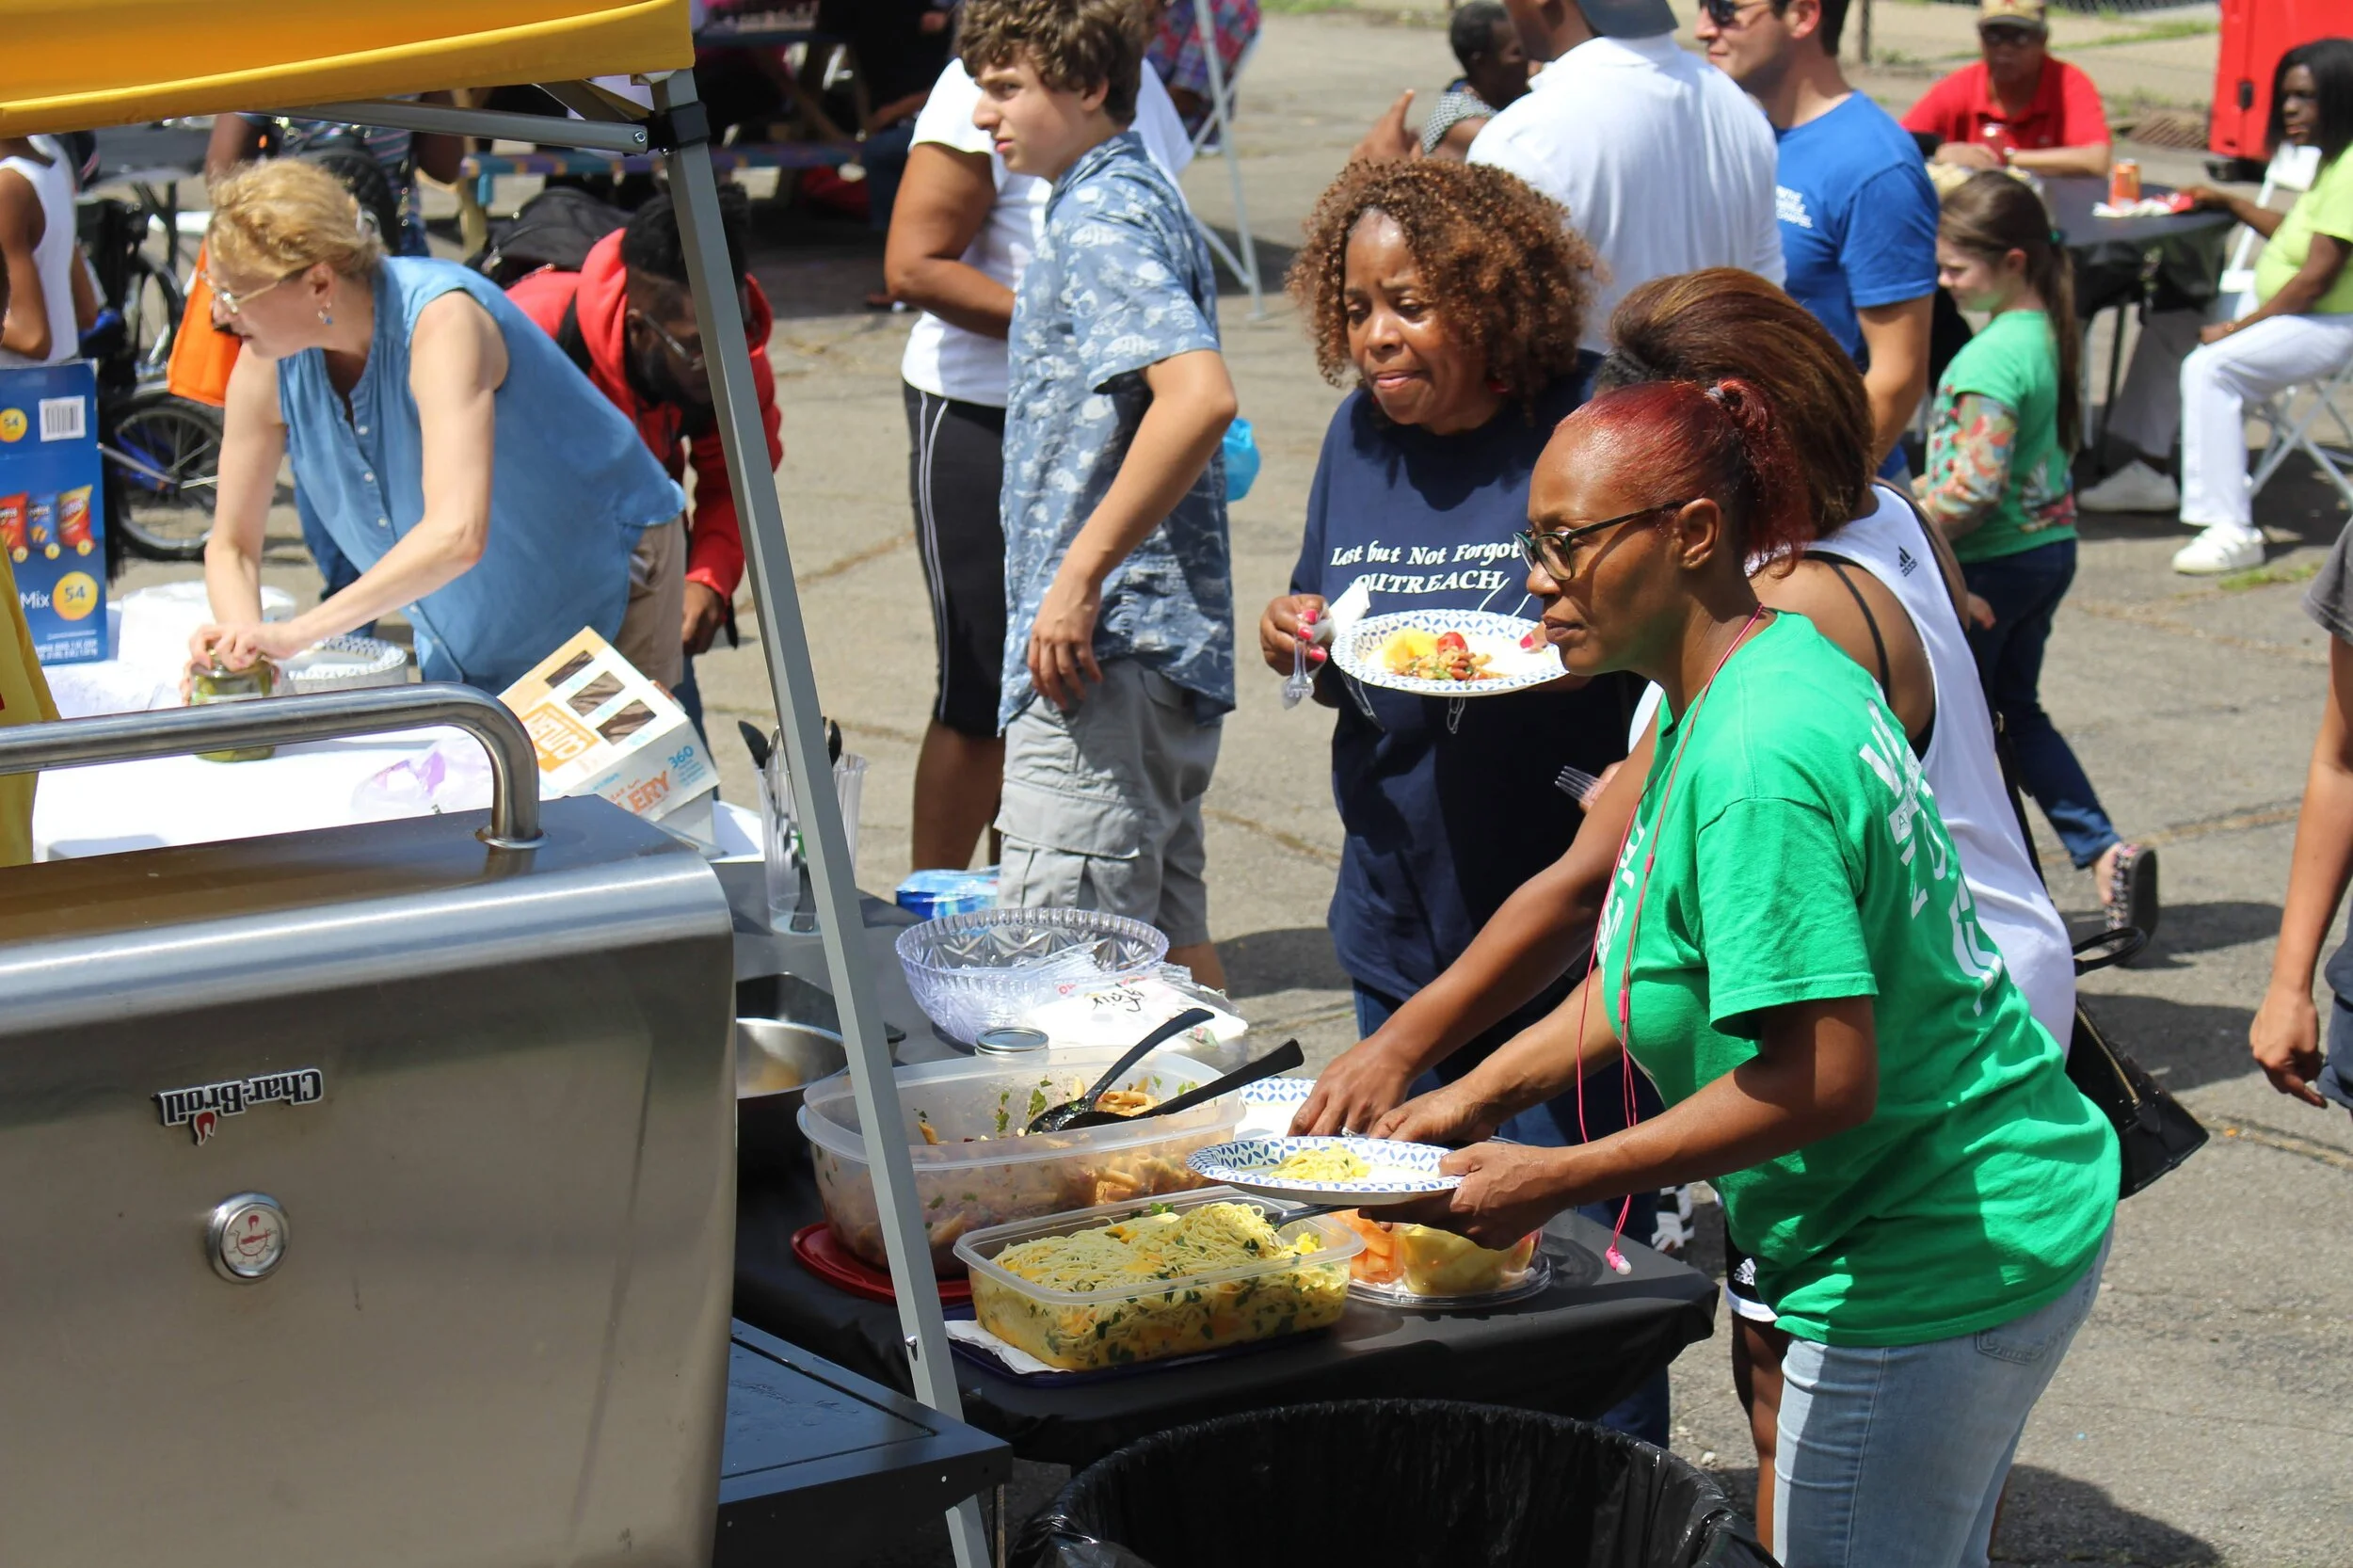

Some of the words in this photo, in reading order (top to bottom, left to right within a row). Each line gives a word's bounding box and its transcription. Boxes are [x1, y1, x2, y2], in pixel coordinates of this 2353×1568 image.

[1366, 539, 1401, 564] but
[1406, 546, 1447, 566] Not
[1451, 540, 1523, 567] Forgot
[20, 590, 50, 610] Mix
[65, 585, 86, 602] 54
[667, 744, 695, 770] 360
[162, 1069, 323, 1126] Char-Broil
